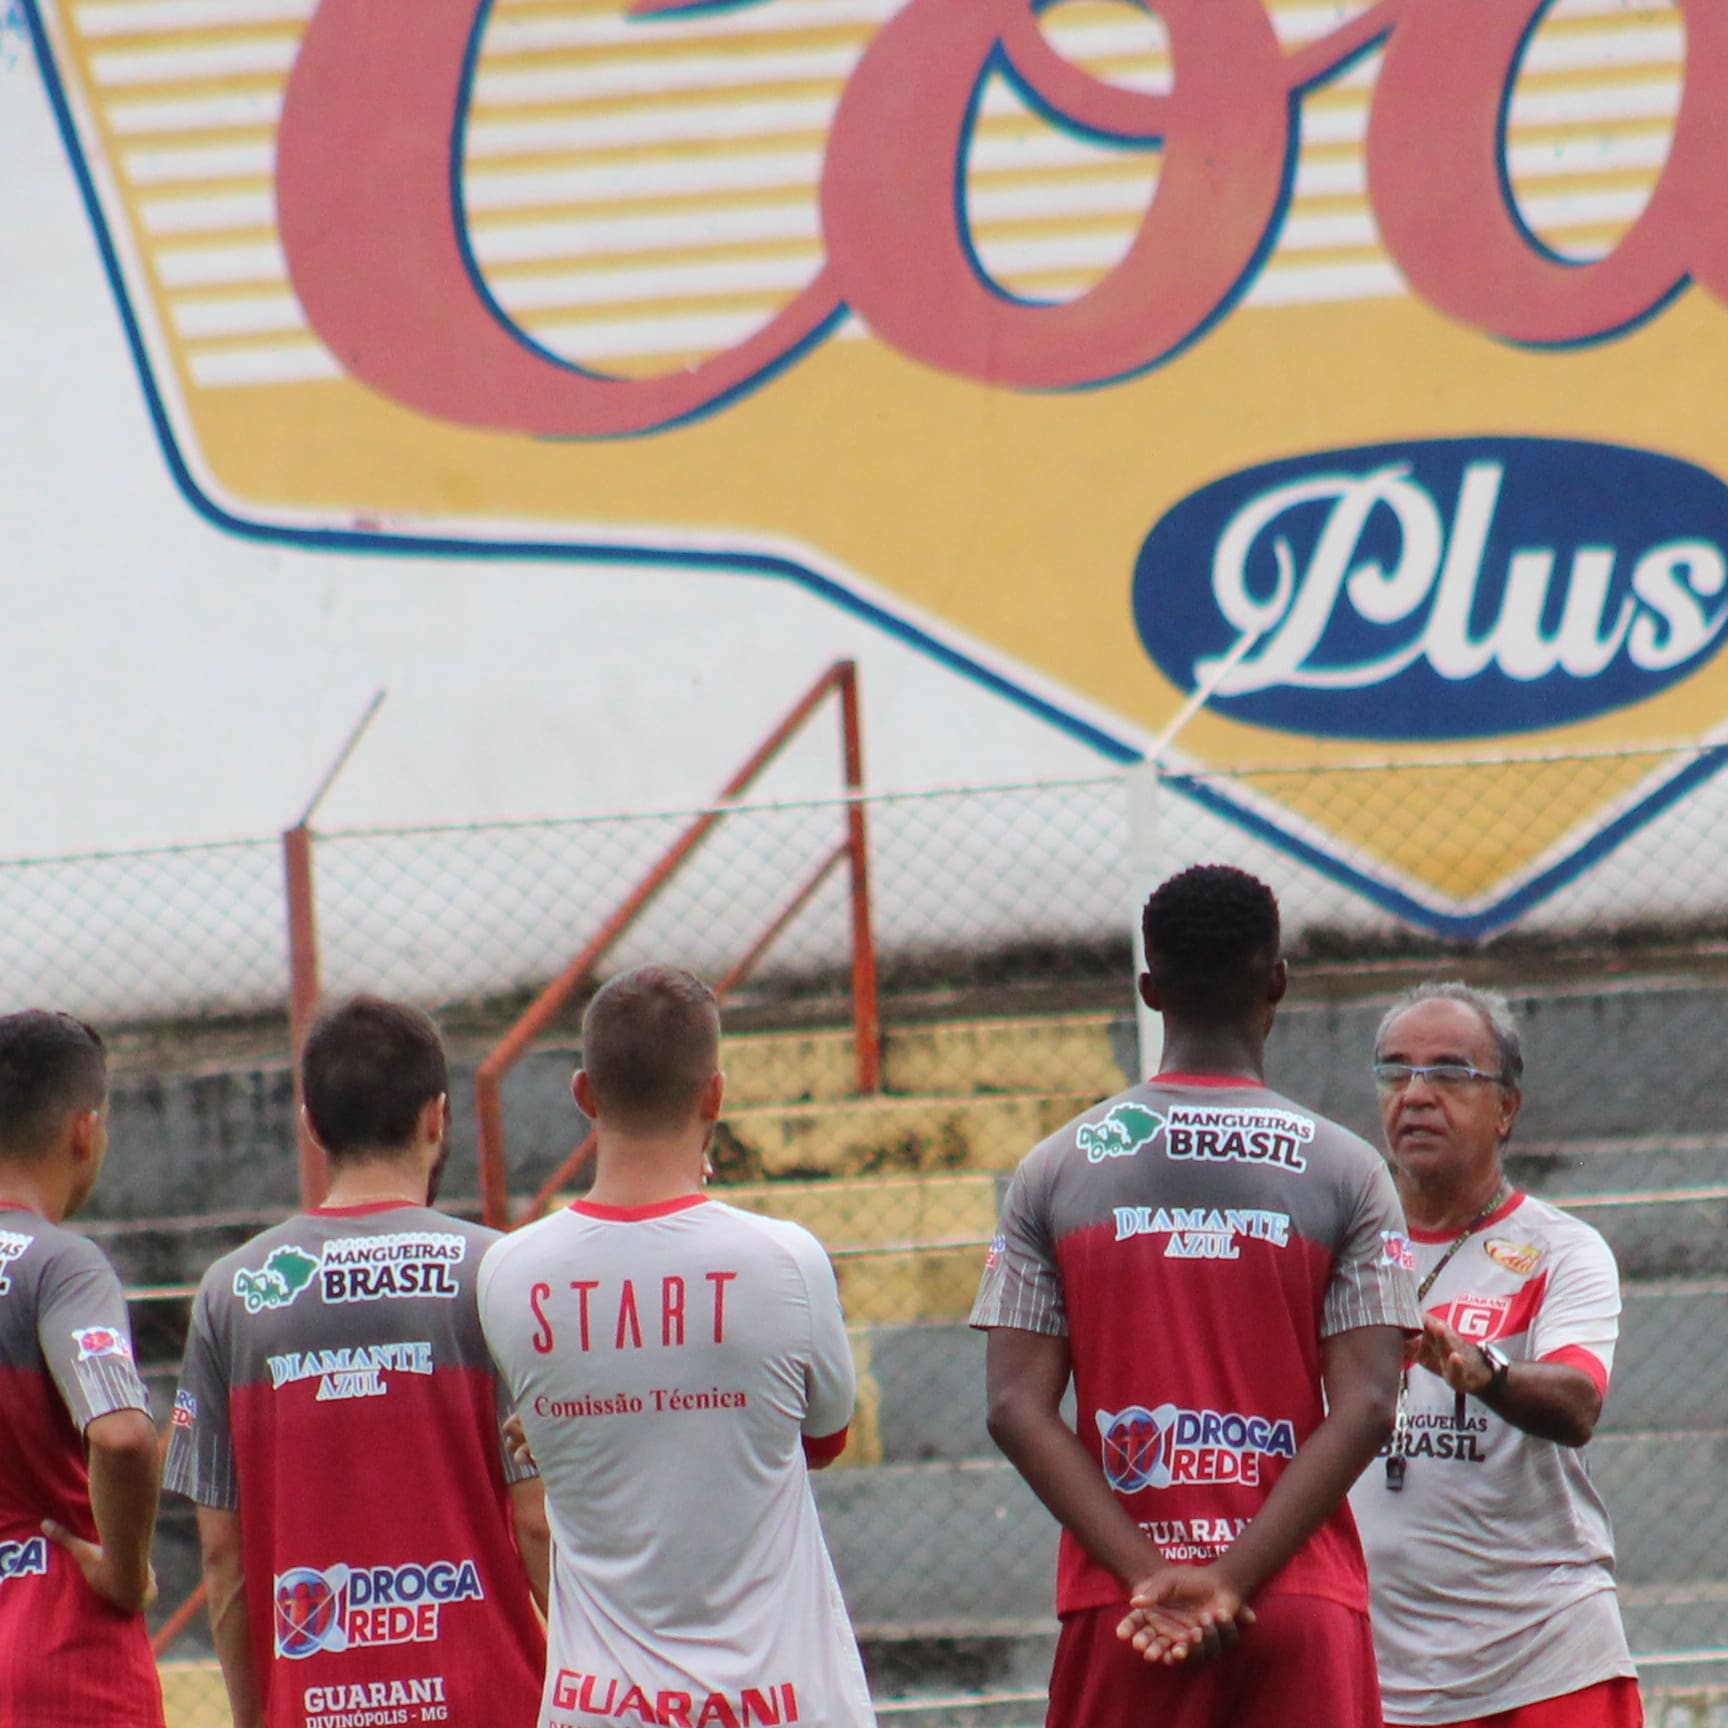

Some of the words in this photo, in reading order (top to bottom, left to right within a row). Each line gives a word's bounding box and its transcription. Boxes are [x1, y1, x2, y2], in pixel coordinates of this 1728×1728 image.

[1170, 1112, 1311, 1141] MANGUEIRAS
[1171, 1129, 1304, 1170] BRASIL
[1113, 1207, 1290, 1248] DIAMANTE
[323, 1244, 461, 1265] MANGUEIRAS
[1164, 1233, 1240, 1259] AZUL
[324, 1262, 454, 1299] BRASIL
[530, 1272, 737, 1354] START
[1458, 1308, 1492, 1336] G
[268, 1342, 433, 1389] DIAMANTE
[316, 1371, 387, 1401] AZUL
[534, 1392, 643, 1418] Comissão
[649, 1387, 747, 1412] Técnica
[1174, 1410, 1295, 1458] DROGA
[1173, 1448, 1259, 1483] REDE
[348, 1564, 482, 1606] DROGA
[348, 1603, 436, 1644] REDE
[304, 1677, 446, 1713] GUARANI
[421, 1706, 449, 1722] MG
